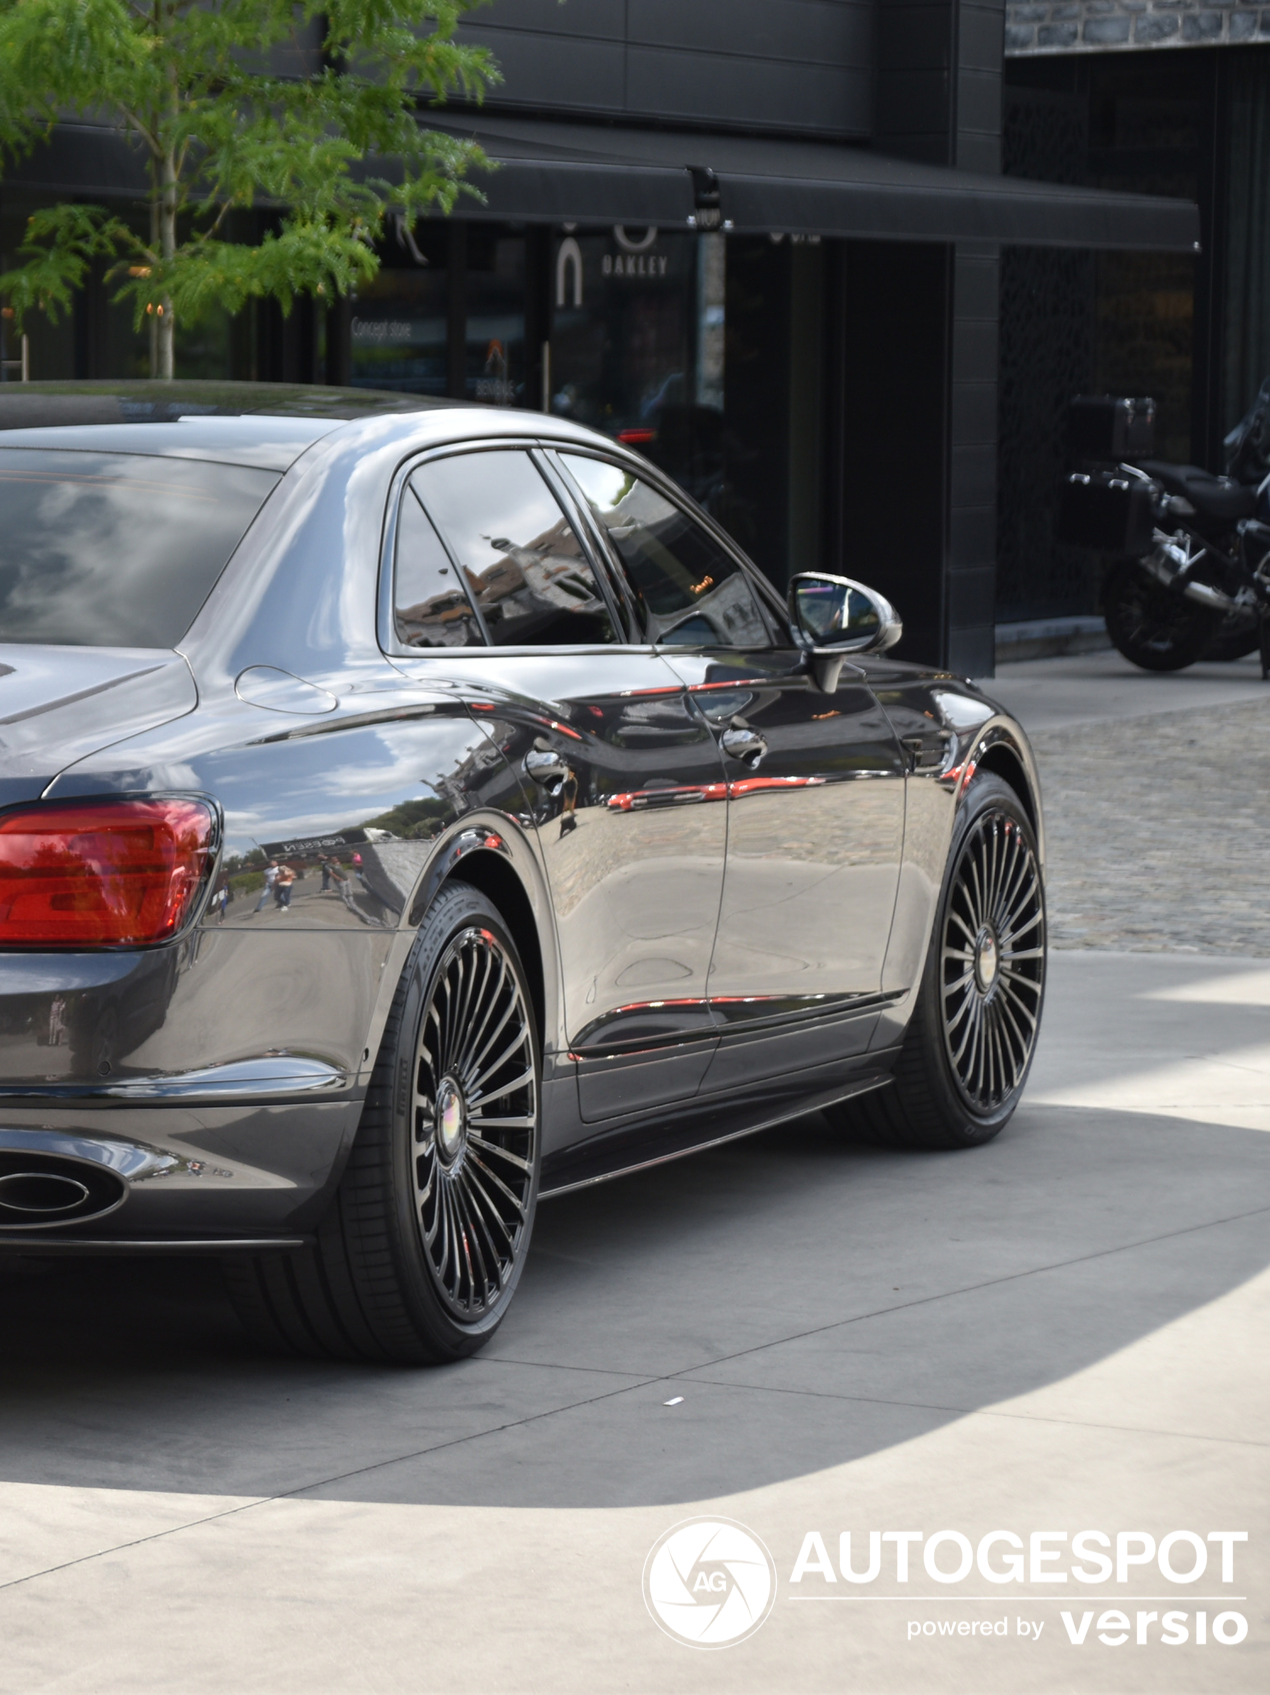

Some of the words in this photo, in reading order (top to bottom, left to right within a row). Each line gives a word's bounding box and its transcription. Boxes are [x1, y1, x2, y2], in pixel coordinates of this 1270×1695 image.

[601, 254, 668, 276] OAKLEY
[351, 316, 387, 341] Concept
[389, 319, 411, 337] store
